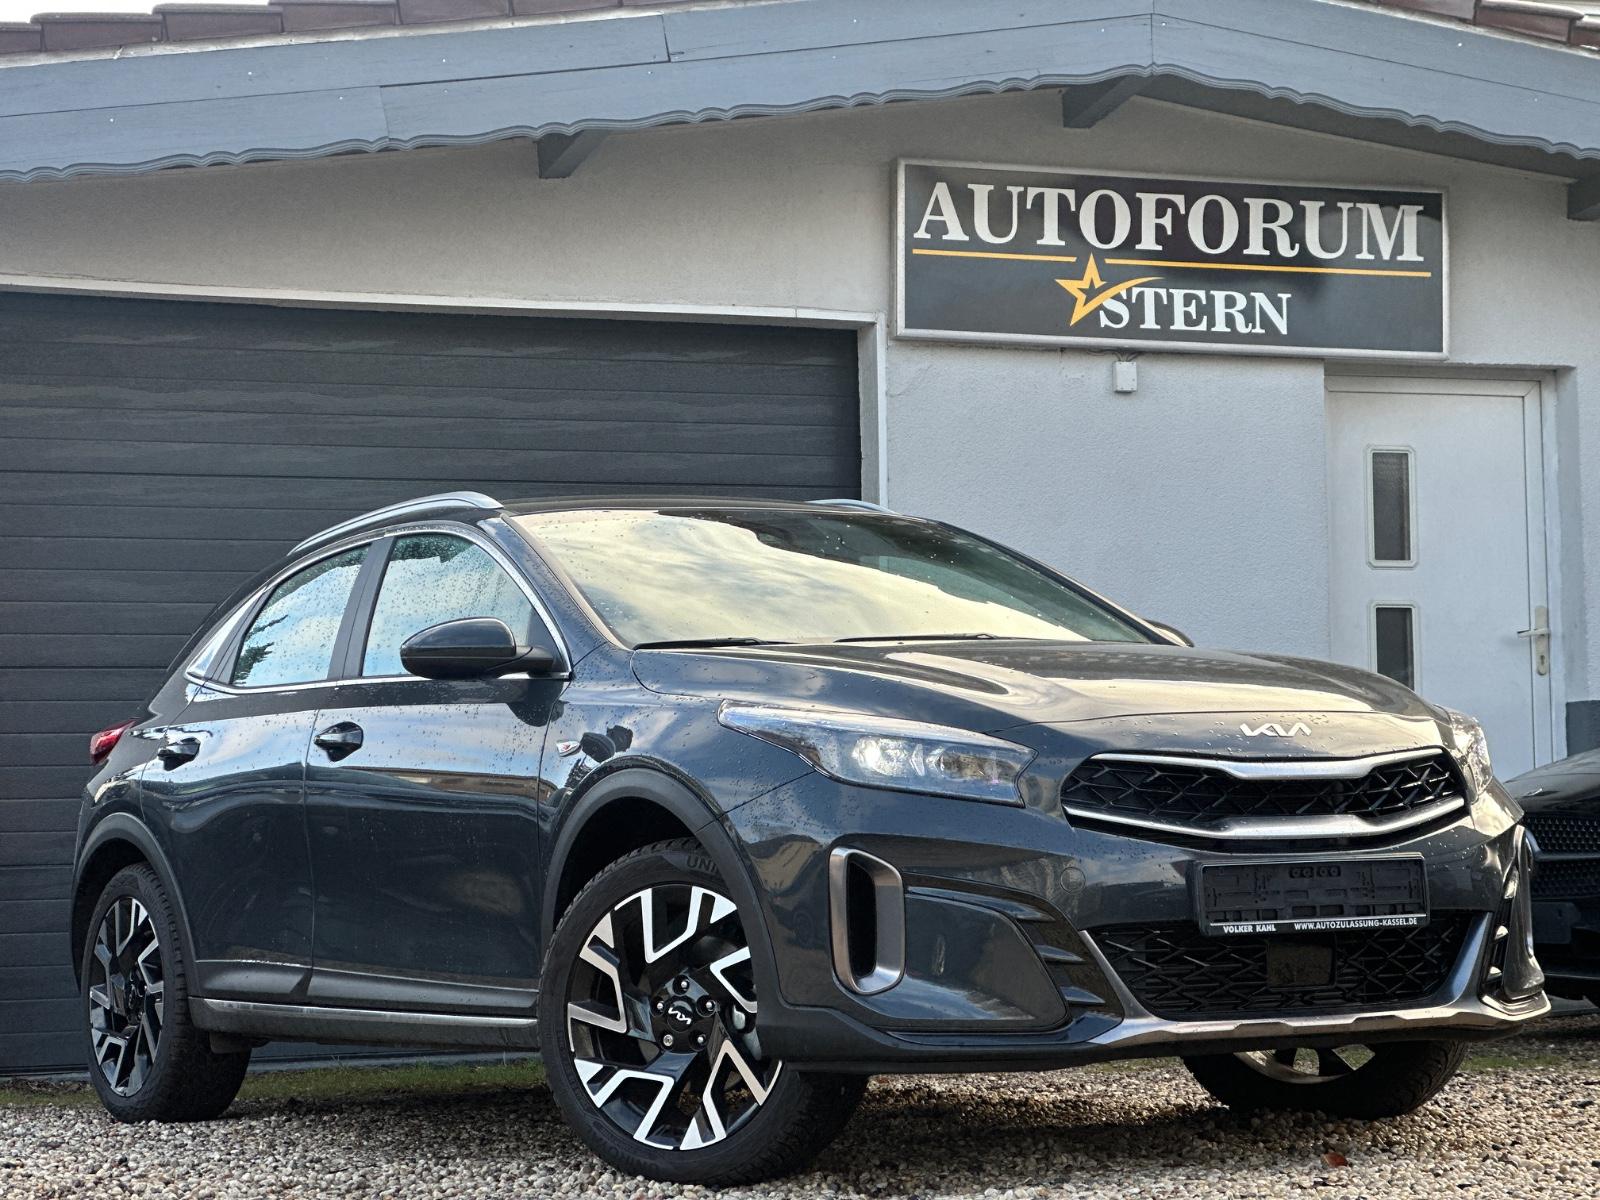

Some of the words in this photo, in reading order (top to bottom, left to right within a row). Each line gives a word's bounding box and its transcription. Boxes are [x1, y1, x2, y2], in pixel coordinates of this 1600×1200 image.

[913, 181, 1425, 262] AUTOFORUM
[1098, 286, 1292, 336] STERN
[1239, 722, 1312, 737] KIA
[1223, 924, 1253, 933] VOLKER
[1255, 923, 1277, 933] KAHL
[1294, 917, 1417, 930] WWW.AUTOZULASSUNG-KASSEL.DE
